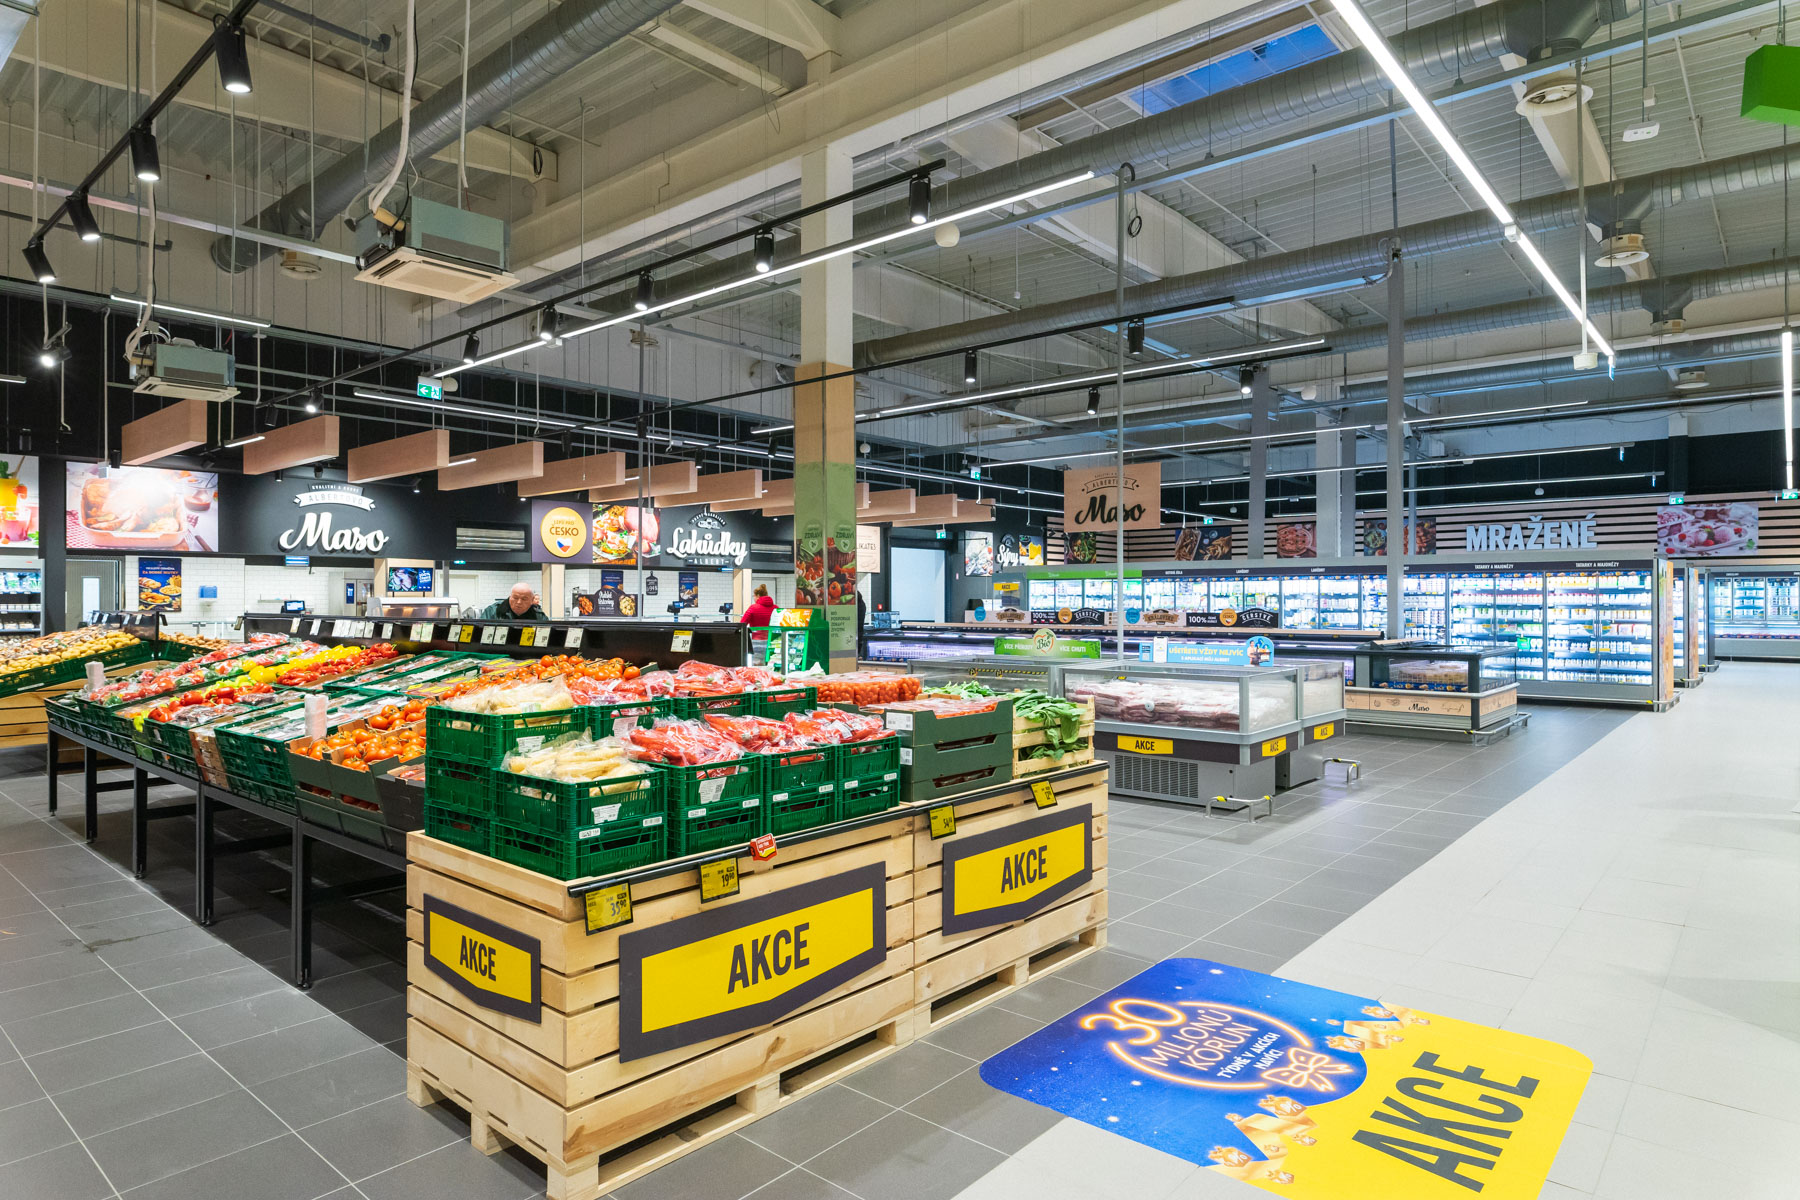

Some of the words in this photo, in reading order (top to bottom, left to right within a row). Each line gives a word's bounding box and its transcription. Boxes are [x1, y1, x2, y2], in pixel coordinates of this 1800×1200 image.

[280, 511, 389, 552] Maso
[550, 524, 579, 536] ČESKO
[666, 527, 748, 566] Lahůdky
[1466, 512, 1597, 551] MRAŽENÉ
[1189, 616, 1207, 624] 100%
[1036, 638, 1050, 650] Bio
[1169, 647, 1198, 655] UŠETŘETE
[1199, 648, 1218, 656] VŽDY
[1219, 648, 1244, 657] NEJVÍC
[1408, 703, 1430, 712] Maso
[1134, 740, 1155, 751] AKCE
[1270, 741, 1279, 752] AKCE
[1001, 845, 1048, 894] AKCE
[459, 934, 497, 982] AKCE
[727, 922, 810, 995] AKCE
[1080, 998, 1186, 1045] 30
[1141, 1009, 1233, 1067] MILIONŮ
[1179, 1022, 1259, 1071] KORUN
[1216, 1055, 1251, 1078] TÝDNĚ
[1250, 1032, 1280, 1054] AKCÍCH
[1352, 1051, 1540, 1193] AKCE
